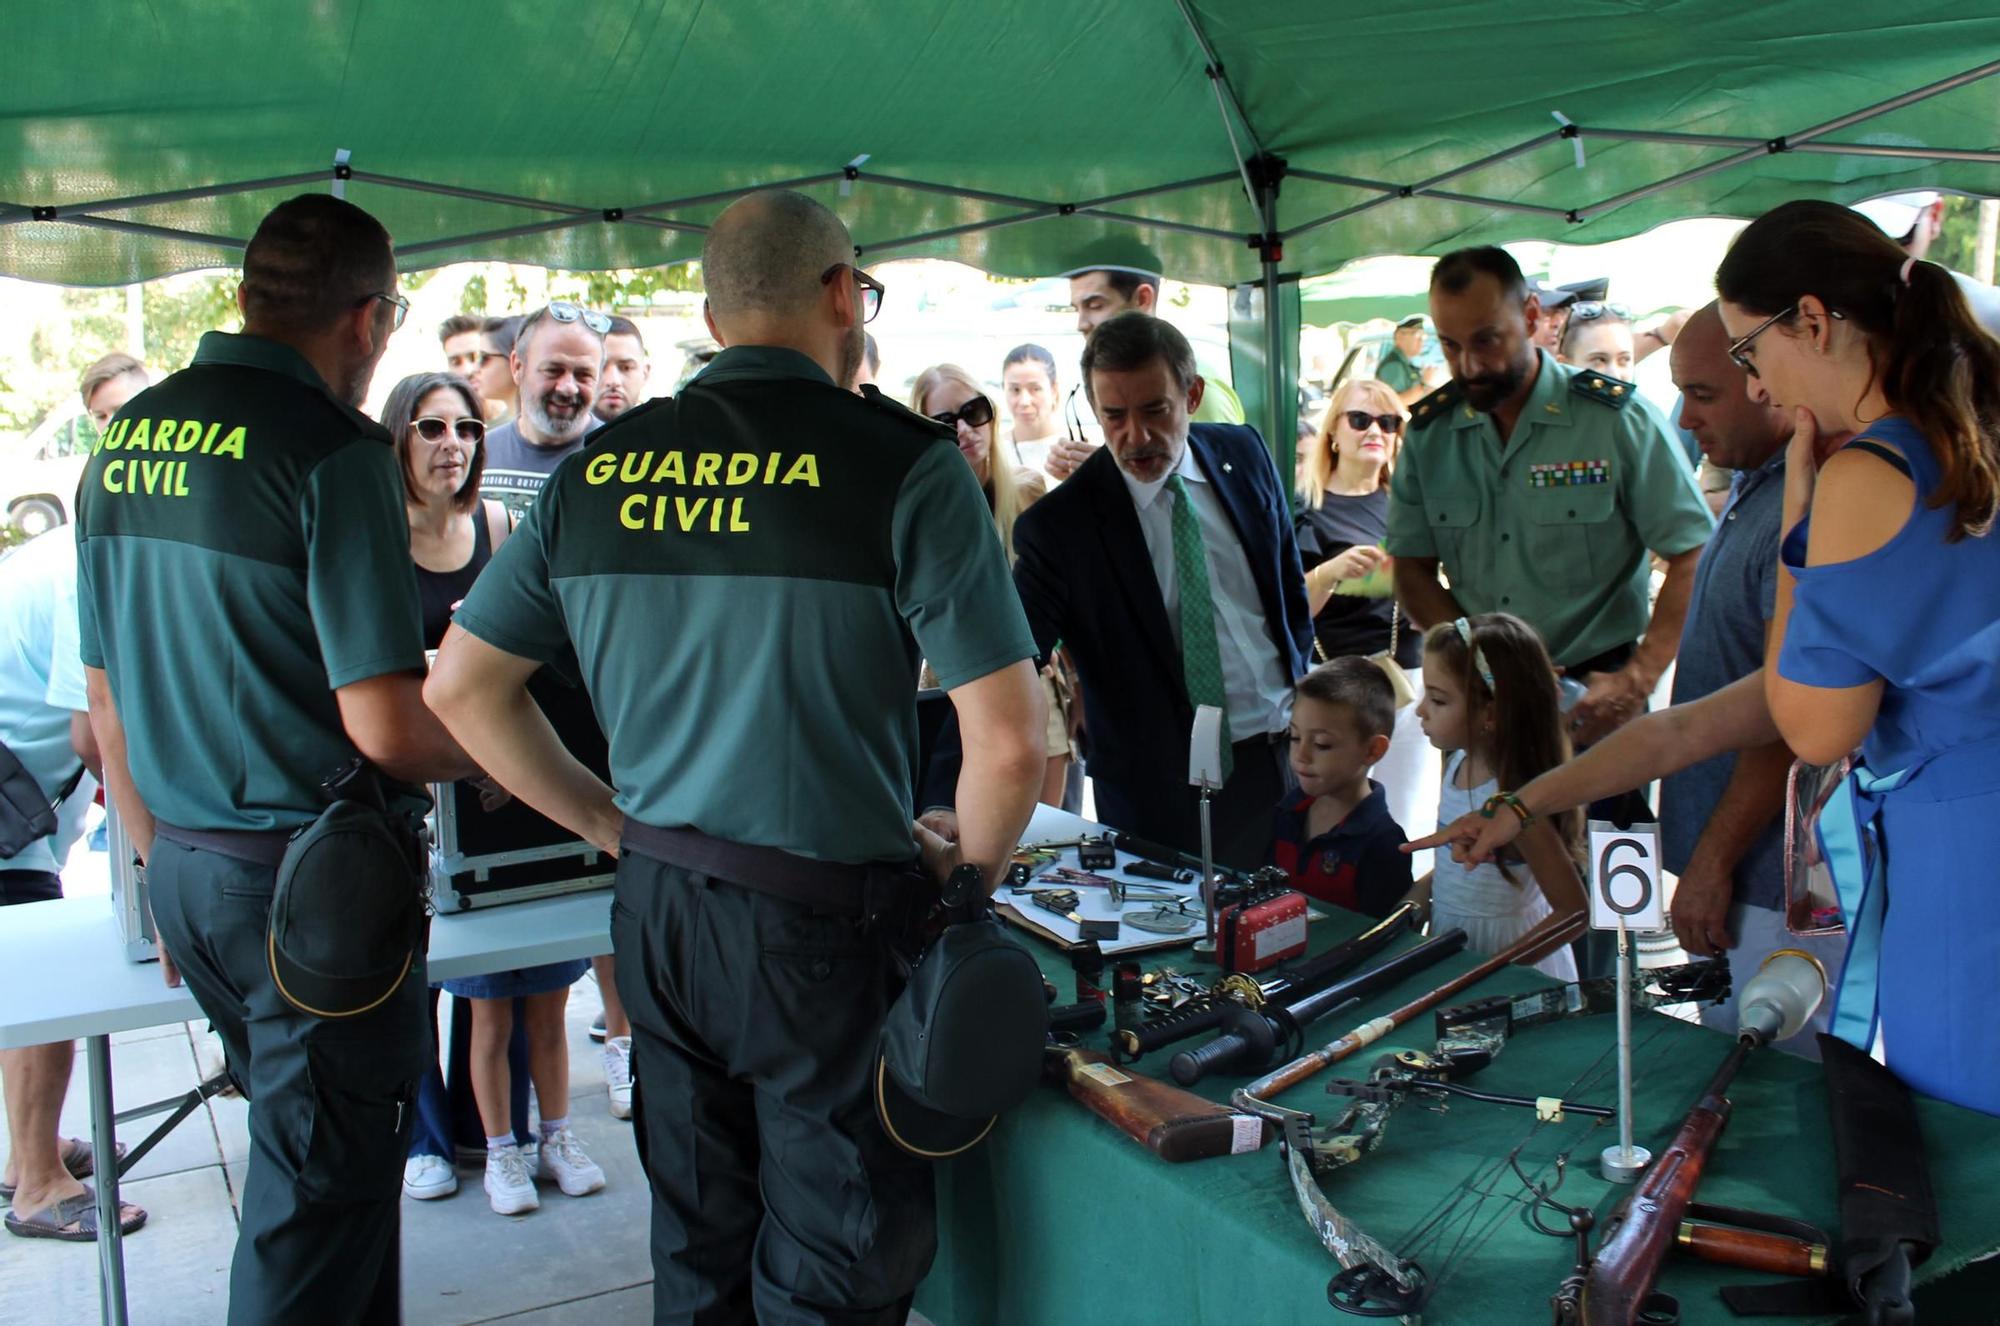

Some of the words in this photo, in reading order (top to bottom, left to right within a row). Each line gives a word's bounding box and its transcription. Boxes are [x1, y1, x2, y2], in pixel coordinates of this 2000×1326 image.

[103, 459, 190, 496] CIVIL
[585, 450, 821, 487] GUARDIA
[619, 493, 750, 532] CIVIL
[1599, 838, 1652, 915] 6
